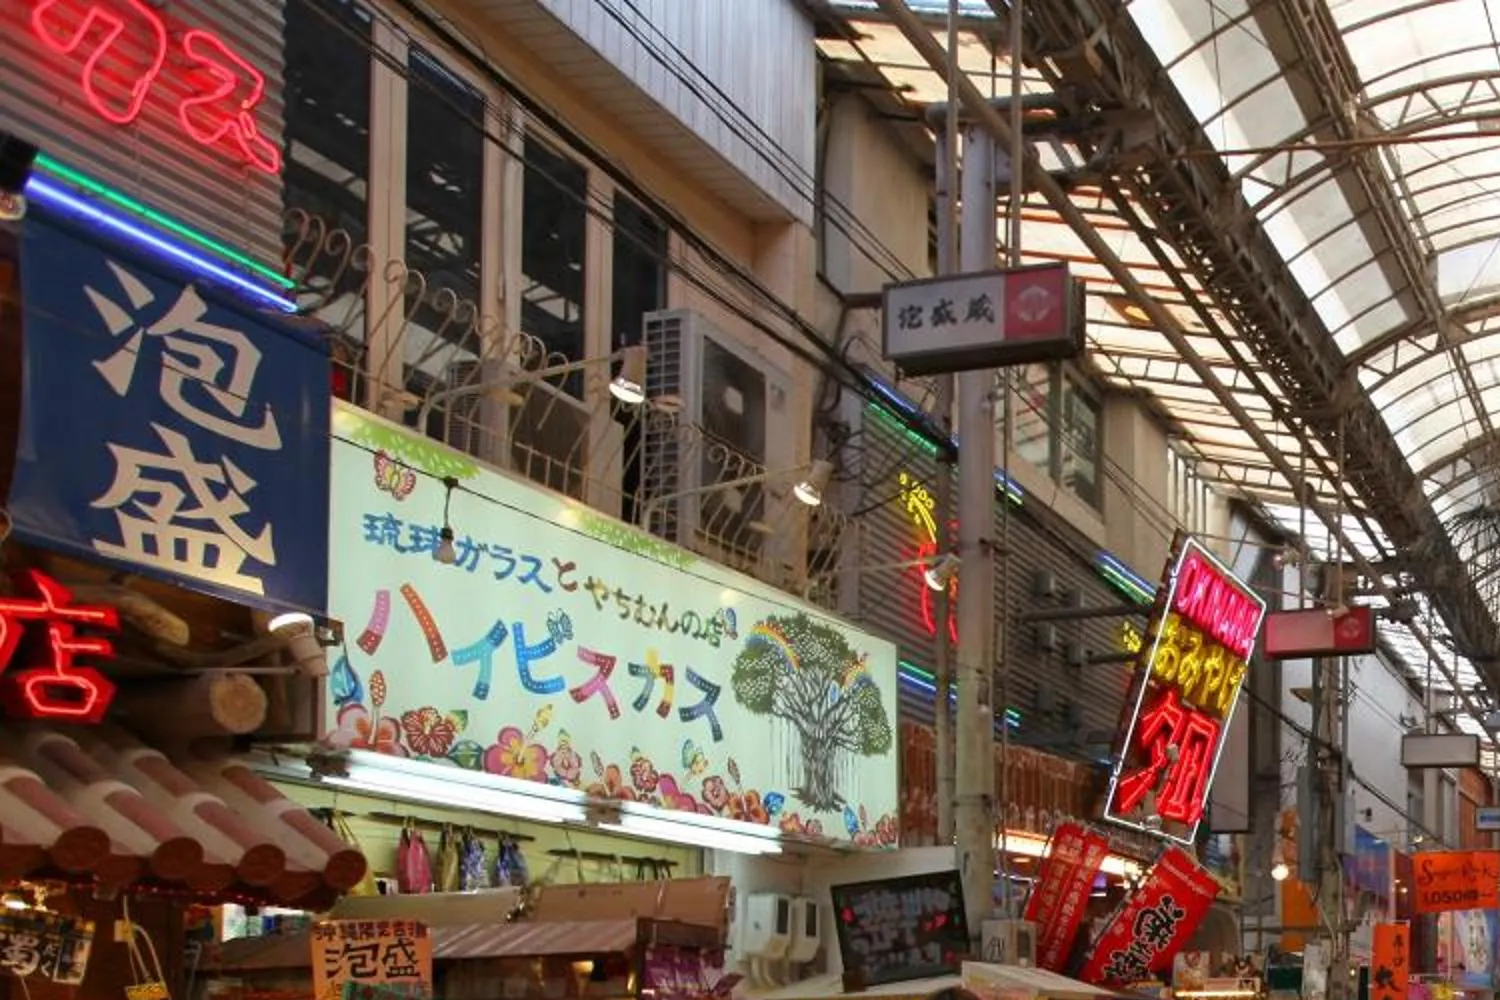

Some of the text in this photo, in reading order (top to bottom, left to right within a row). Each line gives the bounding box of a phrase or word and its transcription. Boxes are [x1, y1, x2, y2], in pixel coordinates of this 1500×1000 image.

[83, 262, 283, 596] 泡盛
[362, 511, 723, 648] 琉球ガラスとやちむんの店
[356, 584, 723, 742] ハイビスカス
[325, 938, 421, 979] 泡盛
